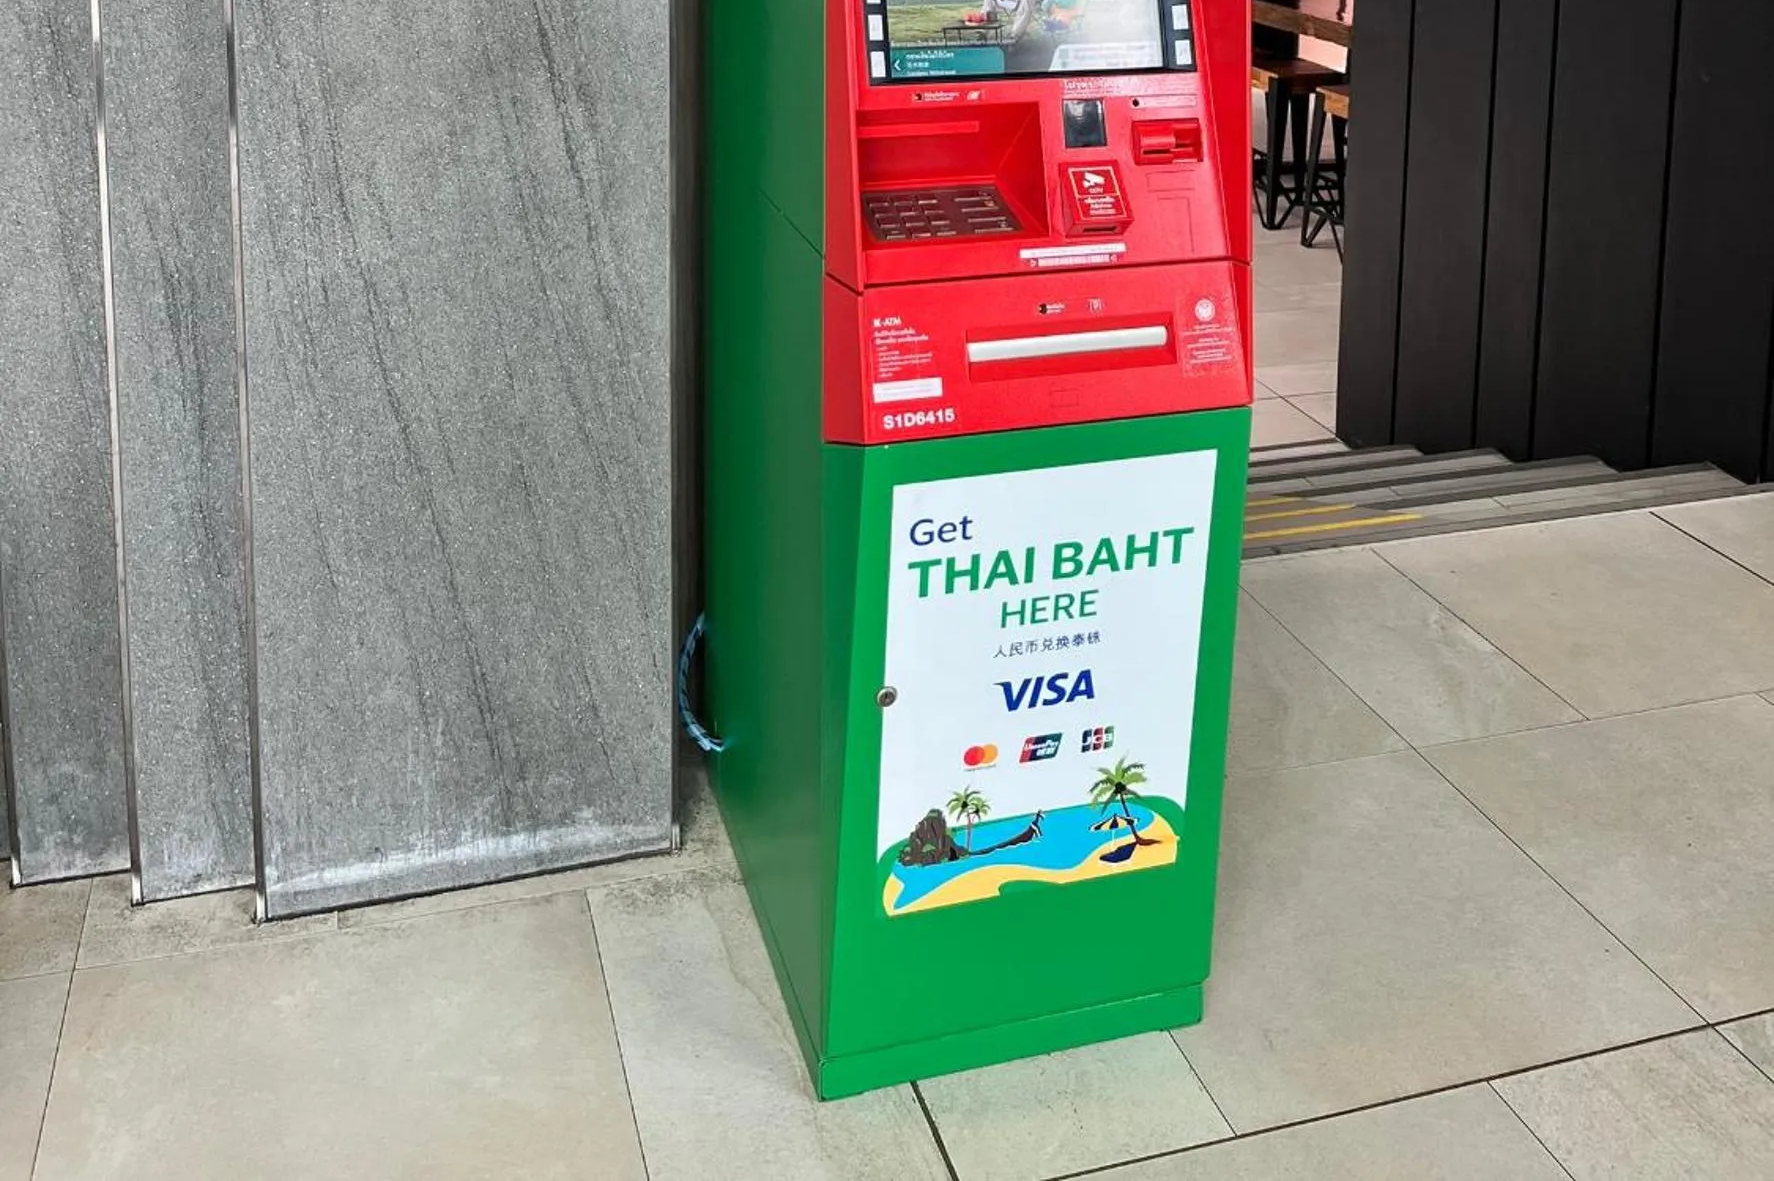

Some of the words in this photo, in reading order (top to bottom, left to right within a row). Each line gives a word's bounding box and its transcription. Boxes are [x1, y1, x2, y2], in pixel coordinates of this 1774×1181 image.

[883, 408, 955, 429] S1D6415
[910, 516, 973, 546] Get
[908, 546, 1036, 598] THAI
[1050, 527, 1195, 580] BAHT
[1001, 589, 1099, 629] HERE
[993, 669, 1095, 712] VISA
